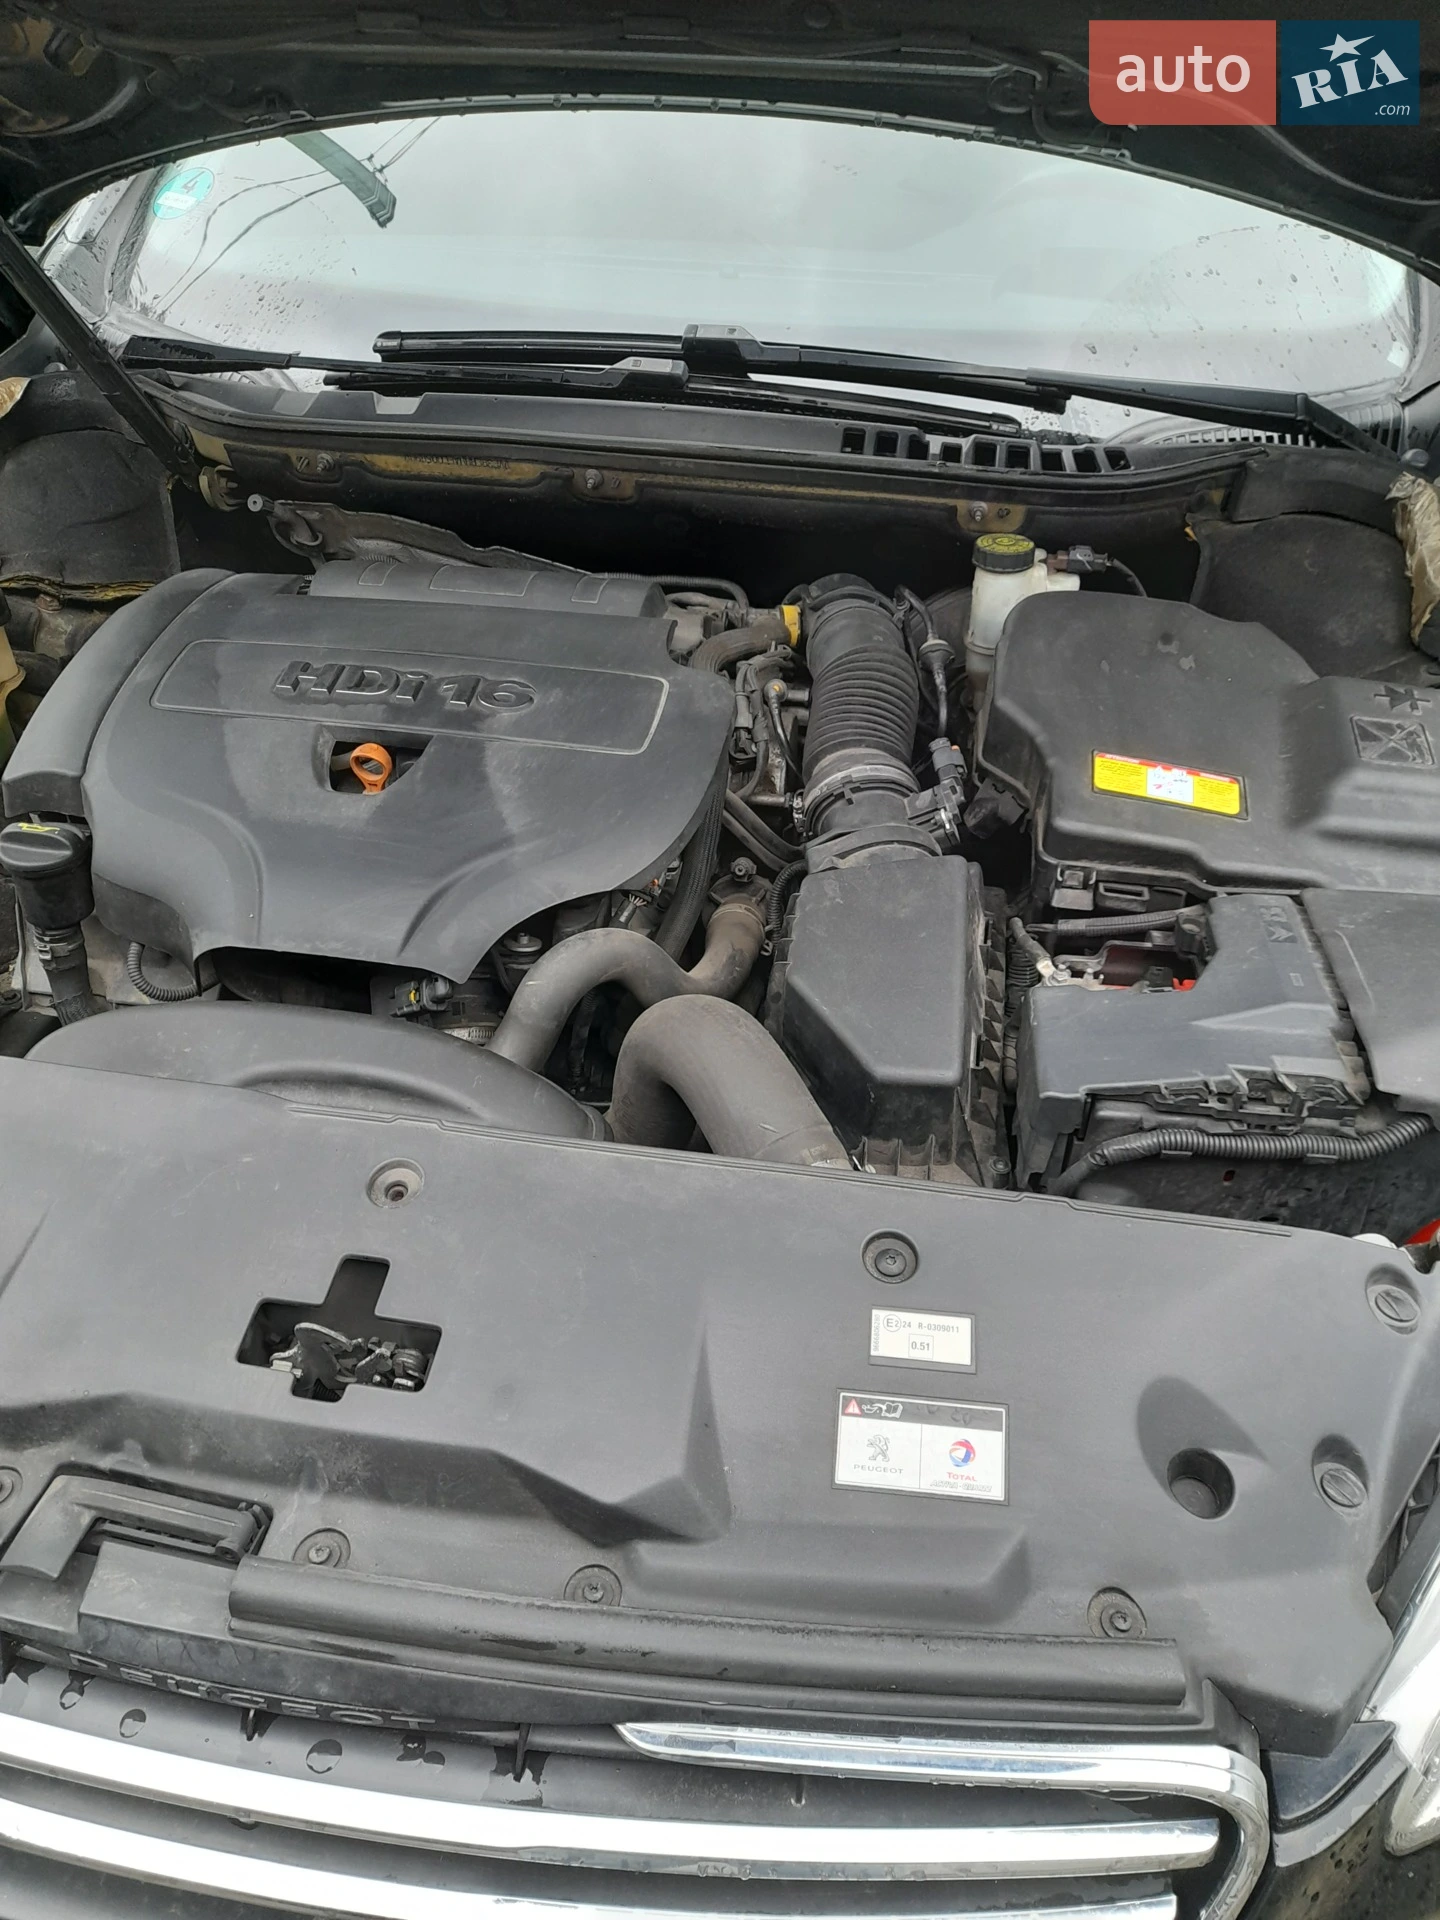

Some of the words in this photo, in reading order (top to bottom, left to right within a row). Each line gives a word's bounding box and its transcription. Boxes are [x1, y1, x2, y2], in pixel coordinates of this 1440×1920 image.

[440, 674, 537, 709] 16
[911, 1341, 930, 1351] 0.51
[853, 1463, 904, 1474] PEUGEOT
[946, 1472, 977, 1482] TOTAL
